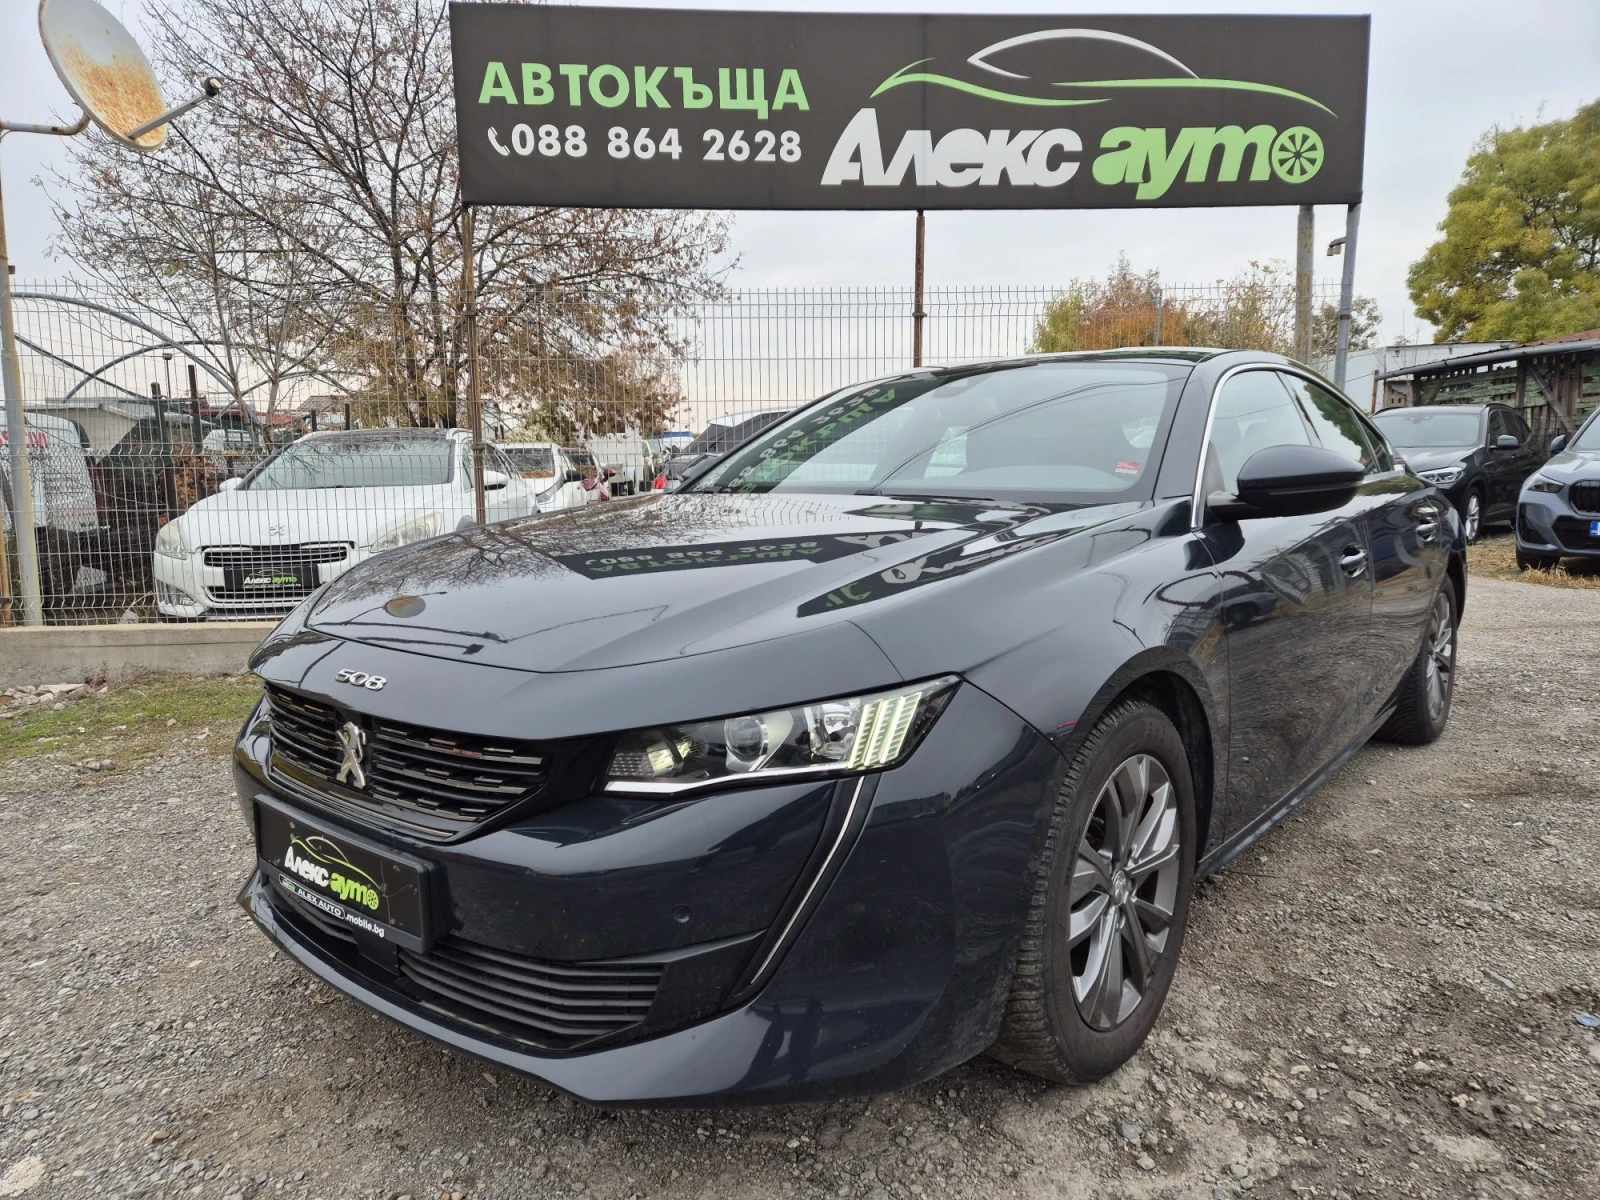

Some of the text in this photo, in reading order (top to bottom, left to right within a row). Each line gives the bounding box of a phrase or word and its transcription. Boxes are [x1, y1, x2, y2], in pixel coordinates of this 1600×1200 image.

[478, 61, 810, 120] АВТОКЪЩА
[511, 123, 802, 163] 088 864 2628
[820, 108, 1084, 188] Алекс
[335, 668, 388, 691] 508
[284, 846, 329, 887] Алекс
[297, 888, 318, 906] ALEX
[319, 899, 342, 917] AUTO
